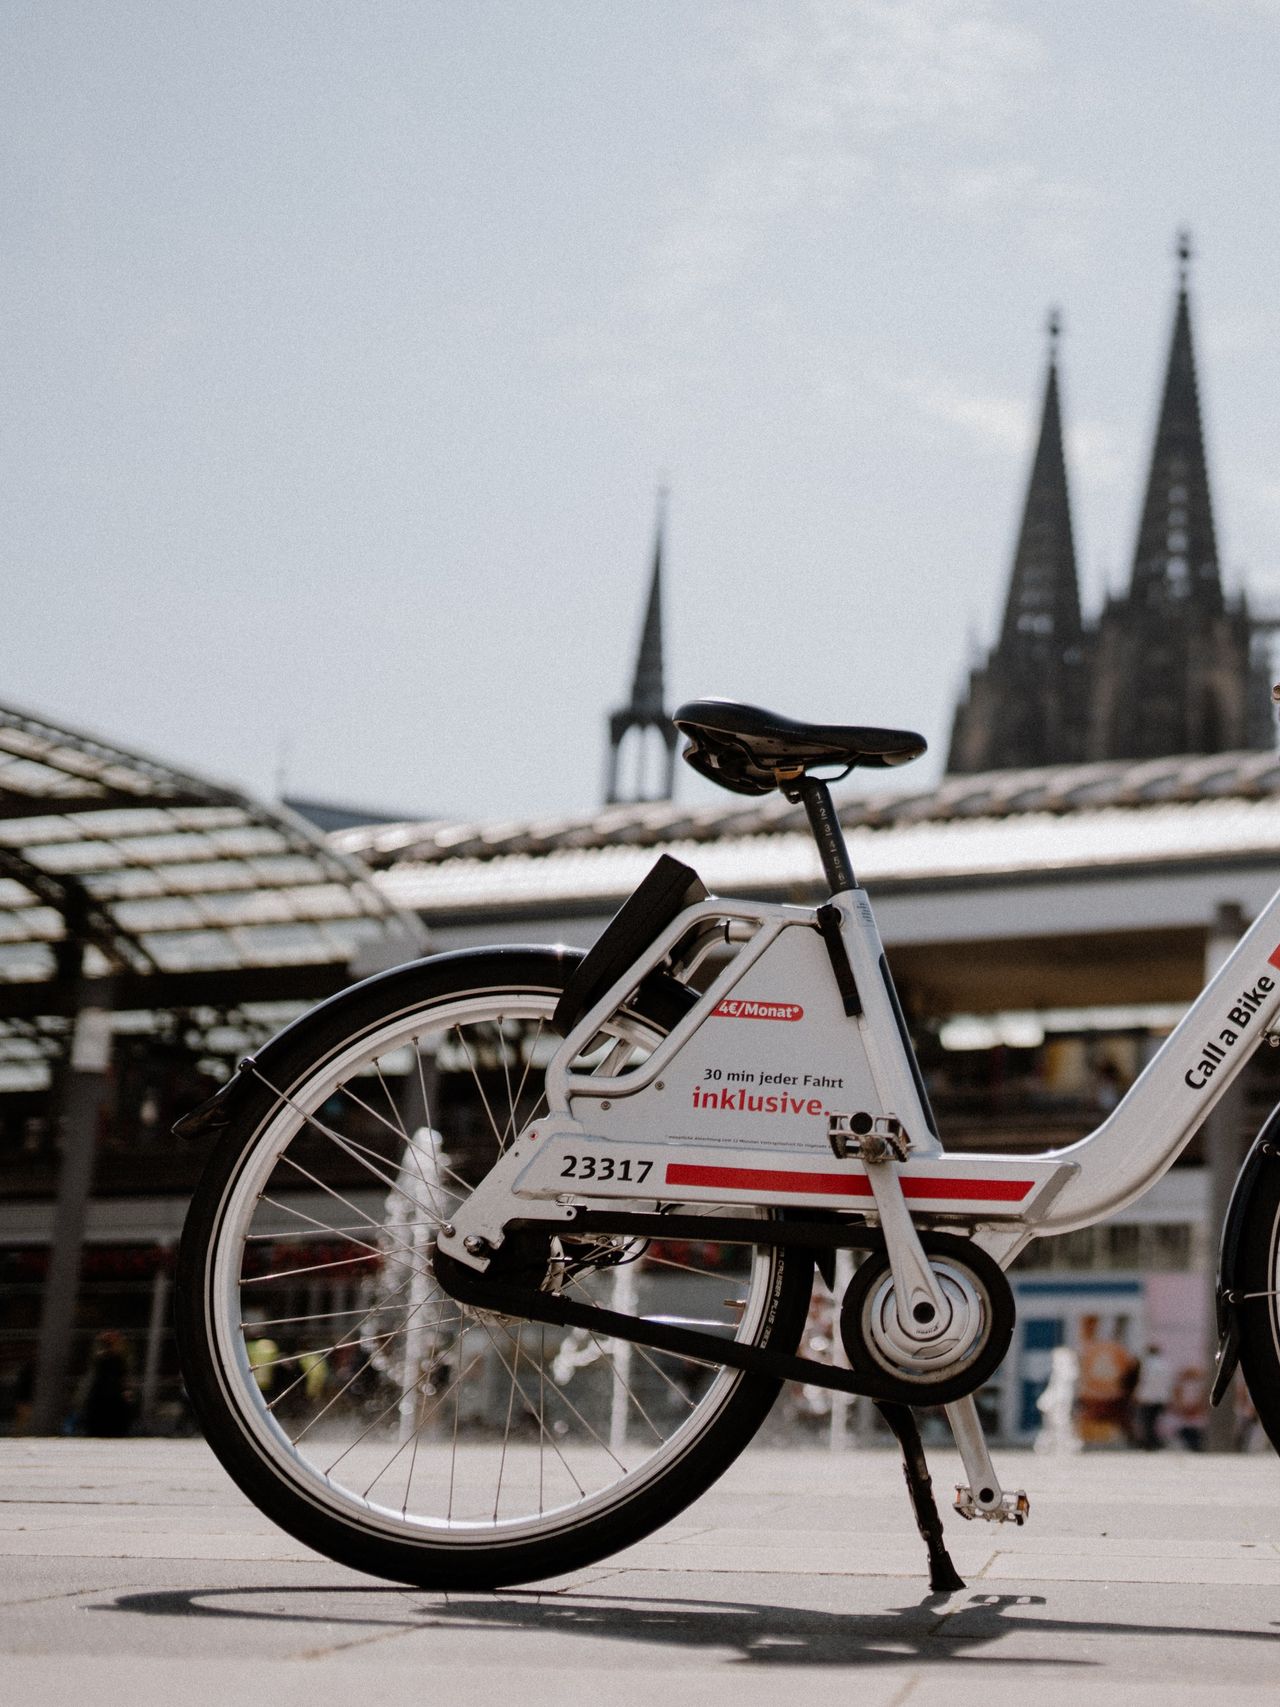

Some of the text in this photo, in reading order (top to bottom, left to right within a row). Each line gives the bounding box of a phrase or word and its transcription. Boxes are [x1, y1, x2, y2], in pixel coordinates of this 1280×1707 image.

[1184, 976, 1275, 1090] Call a Bike
[703, 1068, 844, 1089] 30 min jeder Fahrt
[692, 1086, 831, 1117] inklusive.
[560, 1155, 654, 1184] 23317
[774, 1260, 785, 1298] CRUISER
[768, 1299, 779, 1325] PLUS
